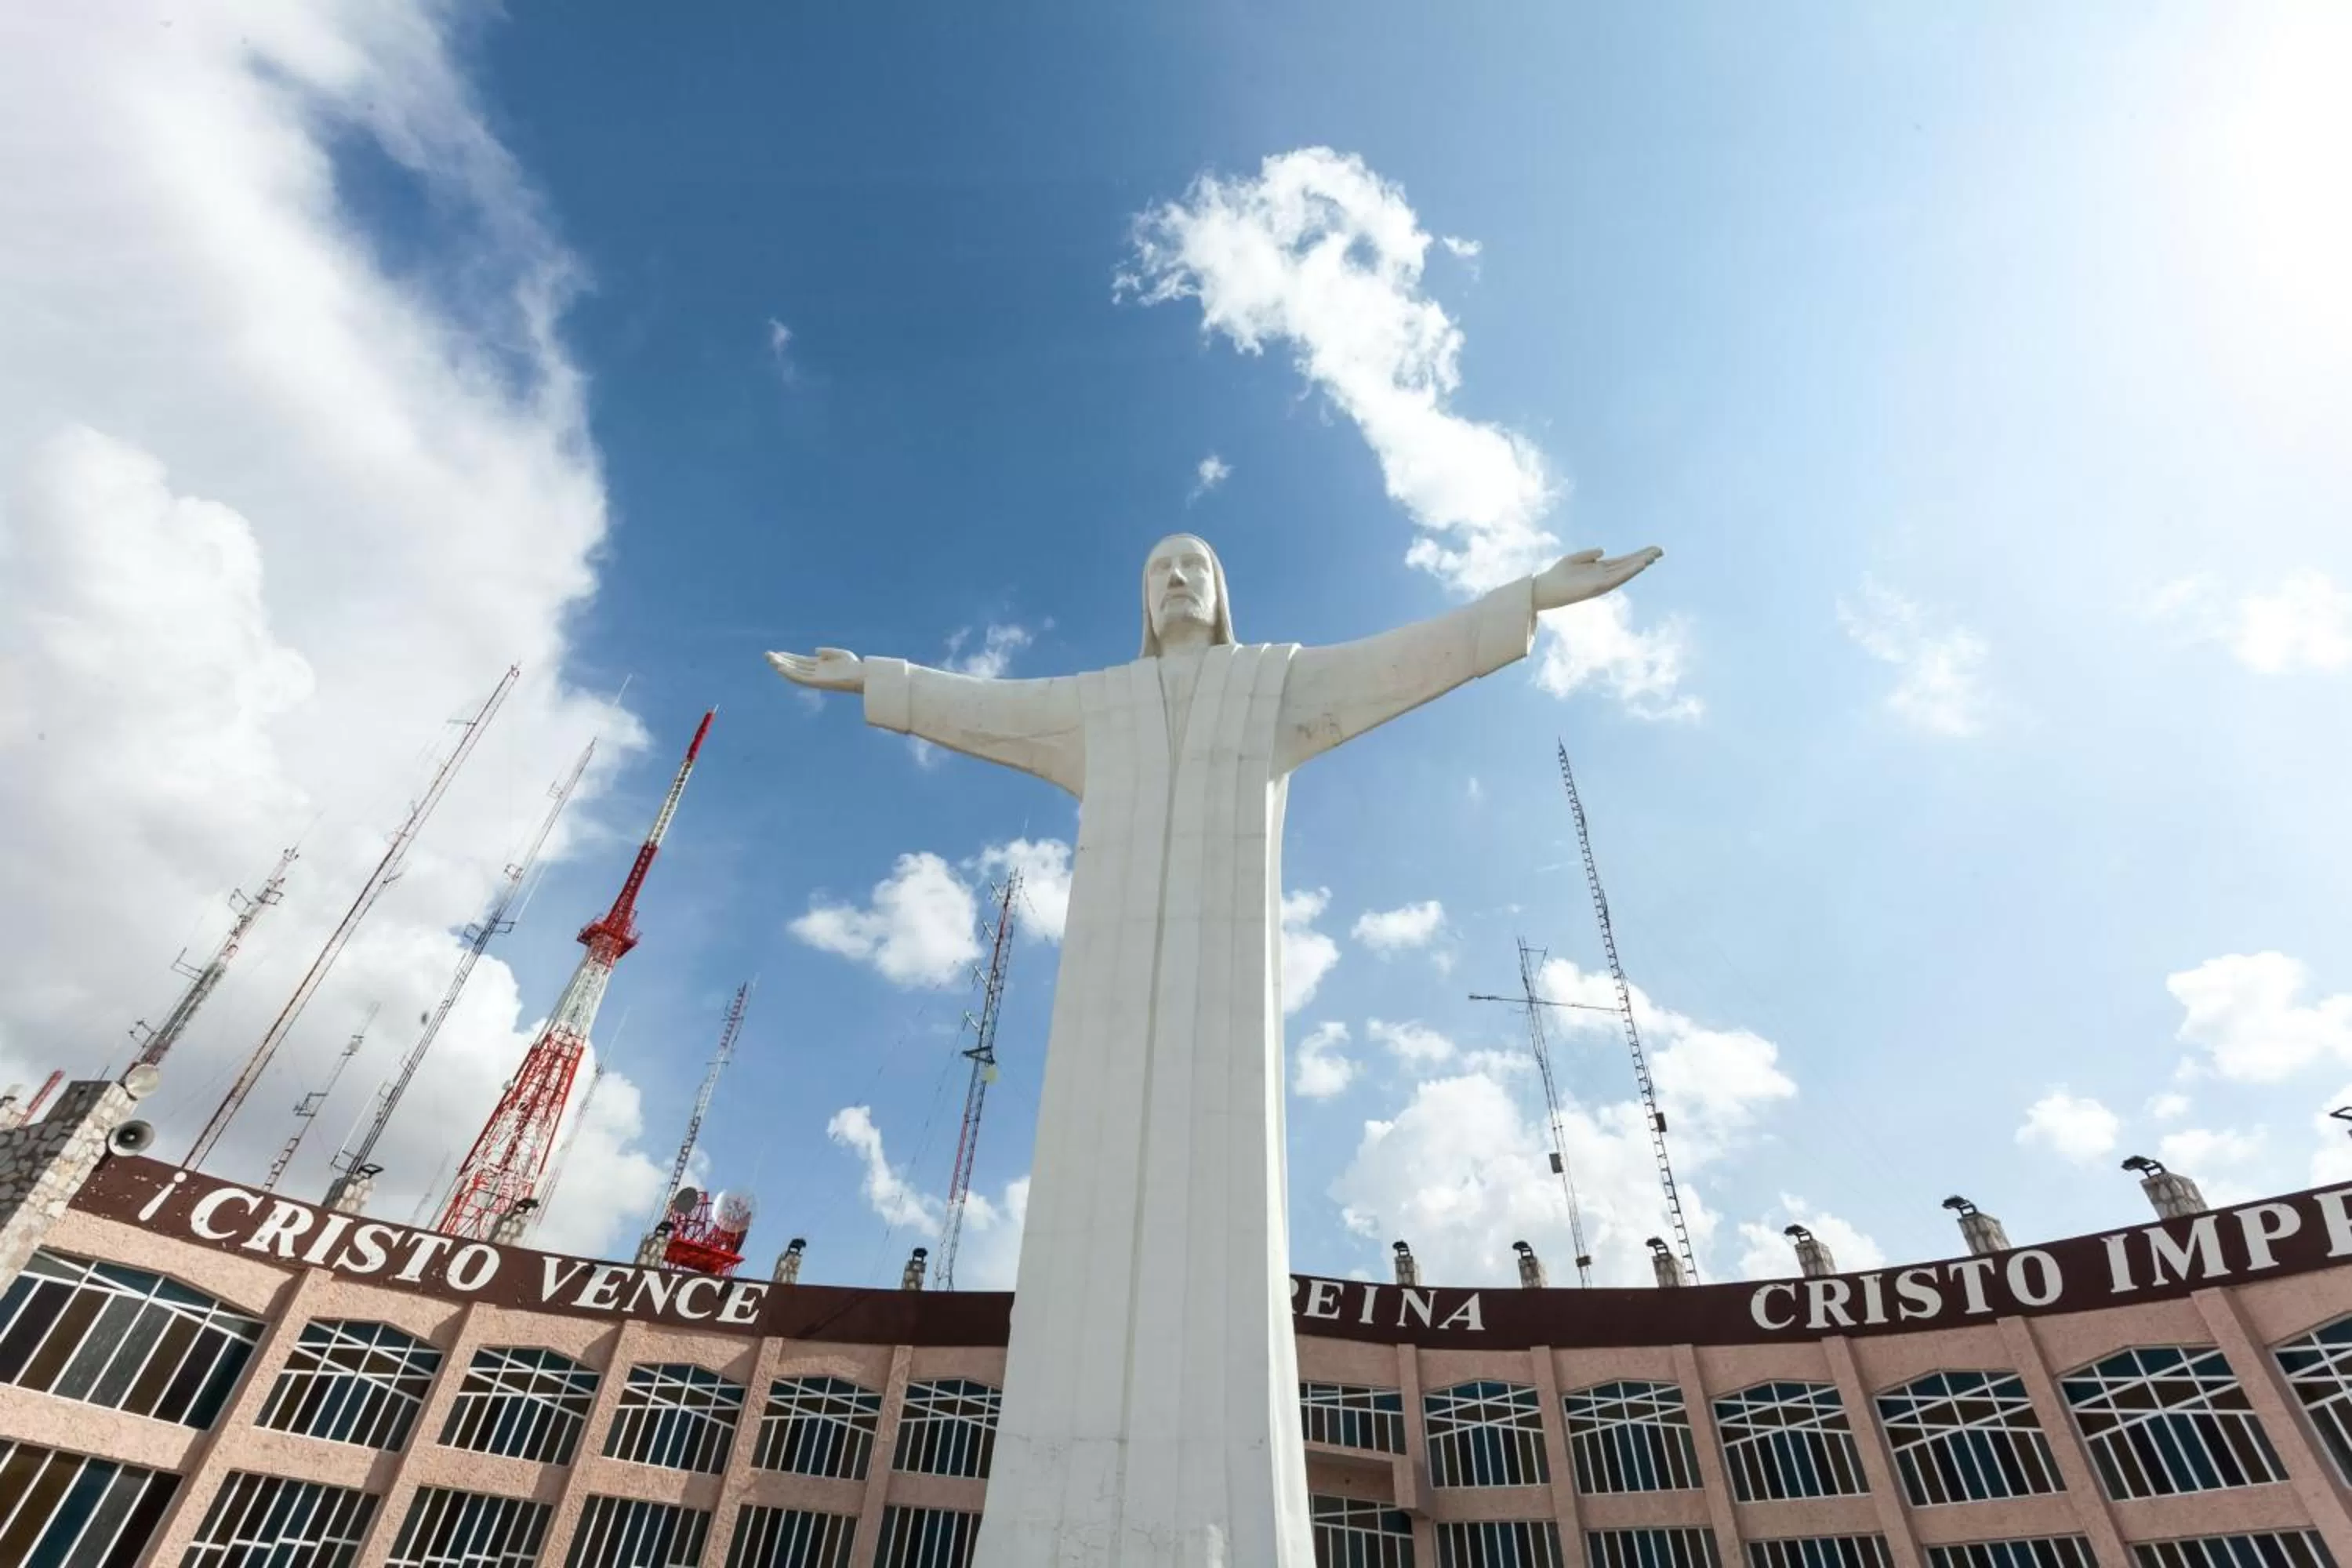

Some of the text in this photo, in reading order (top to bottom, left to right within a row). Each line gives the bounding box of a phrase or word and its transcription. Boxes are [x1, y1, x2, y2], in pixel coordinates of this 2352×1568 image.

[540, 1255, 770, 1325] VENCE
[1290, 1278, 1486, 1331] EINA
[1750, 1249, 2063, 1330] CRISTO
